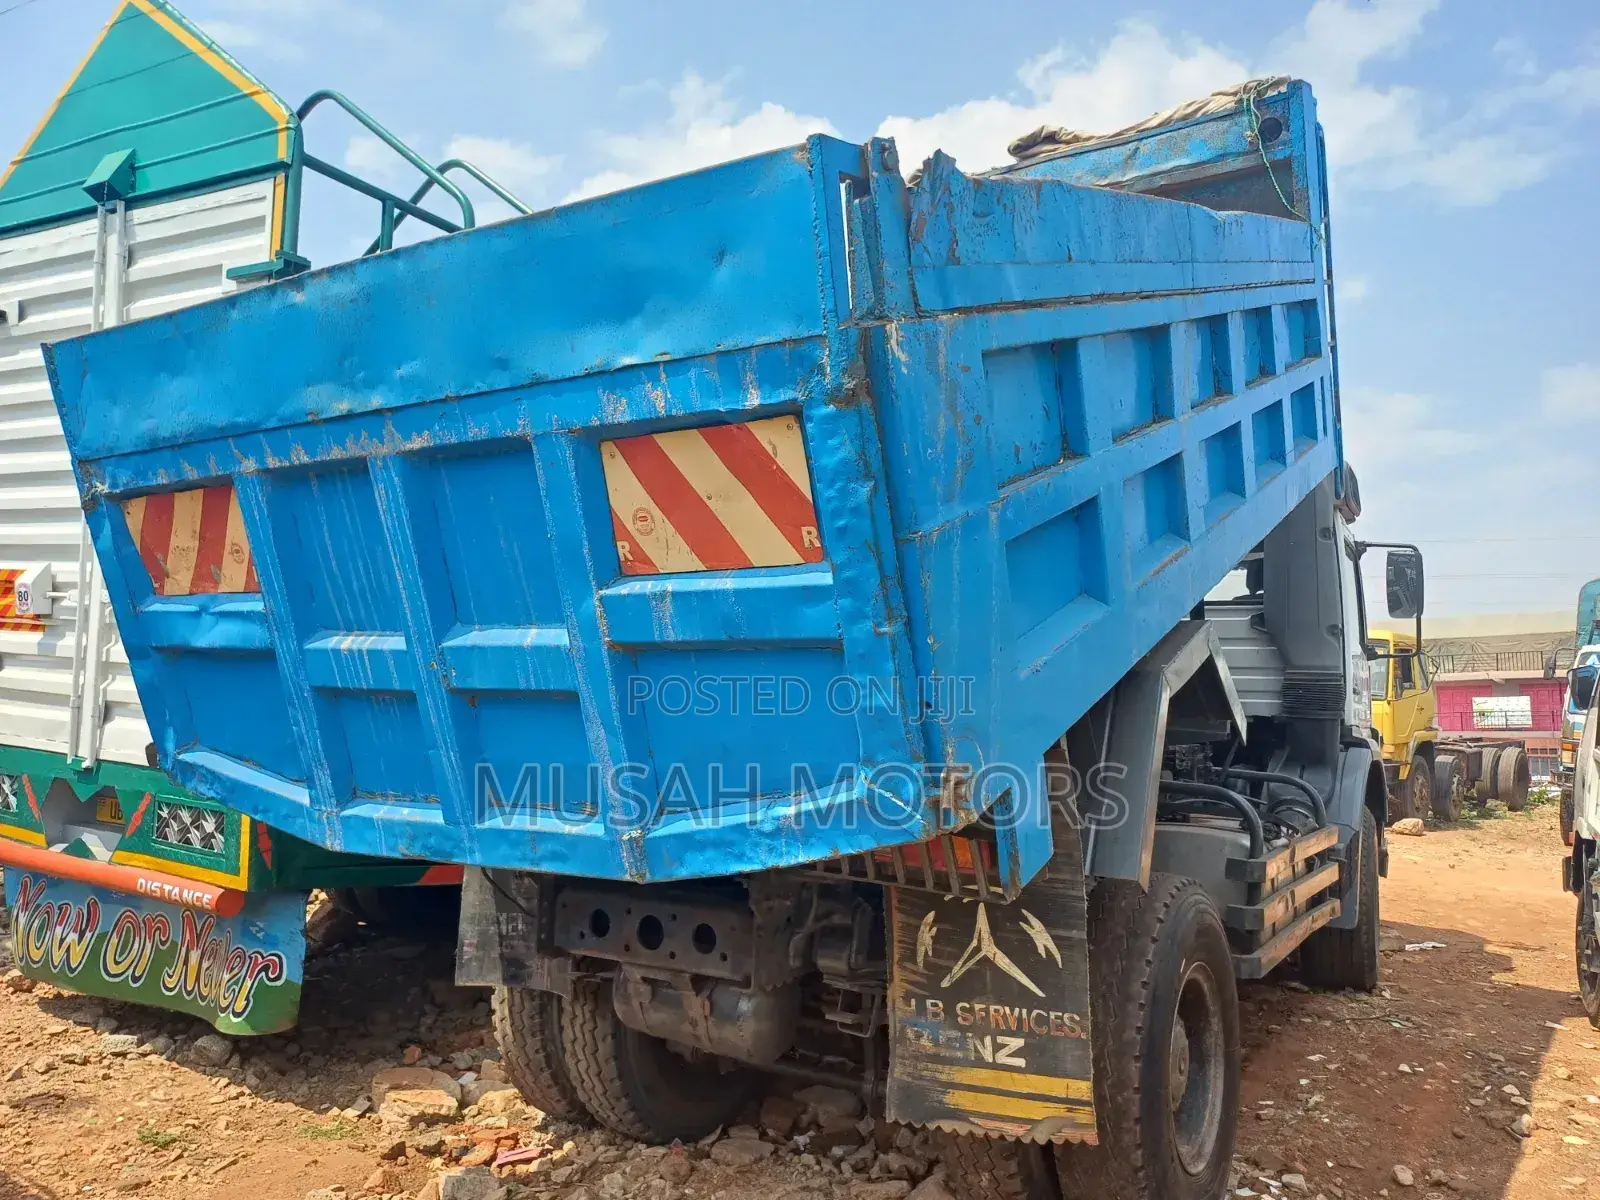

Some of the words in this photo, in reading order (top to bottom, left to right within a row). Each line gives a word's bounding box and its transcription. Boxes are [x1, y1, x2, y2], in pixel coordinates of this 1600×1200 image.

[17, 590, 28, 601] 80
[136, 877, 213, 909] DISTANCE
[11, 874, 102, 978] Now
[160, 908, 287, 1023] Never
